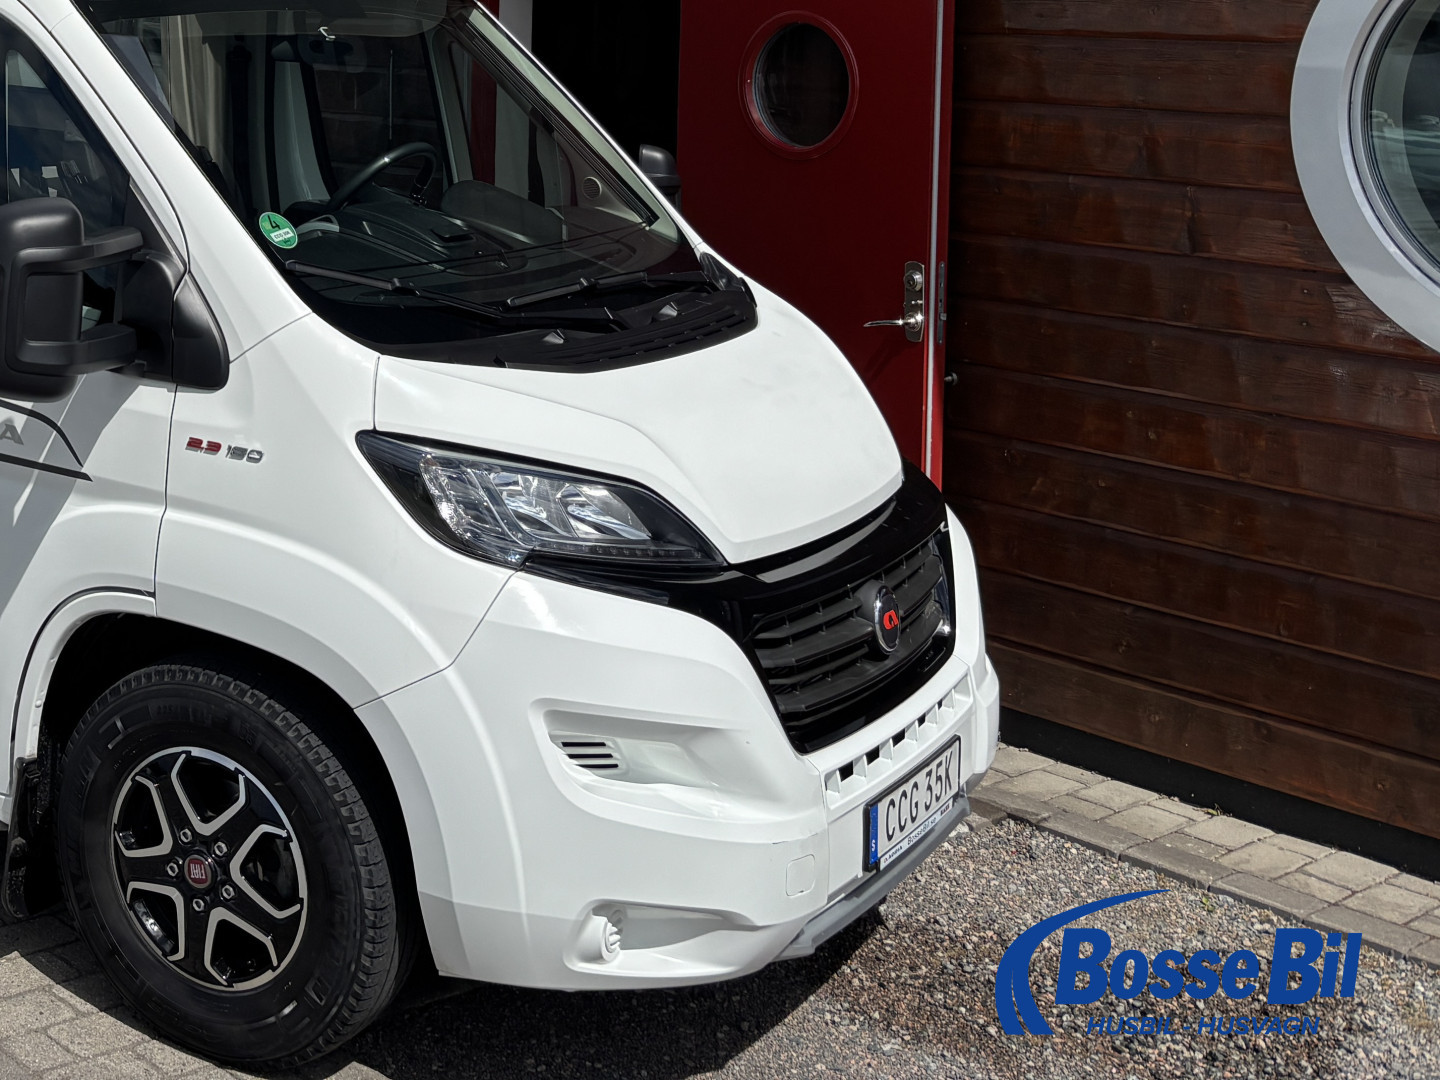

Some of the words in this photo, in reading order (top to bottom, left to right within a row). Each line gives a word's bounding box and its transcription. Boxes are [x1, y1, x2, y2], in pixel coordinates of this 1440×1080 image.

[267, 214, 281, 230] 4
[185, 436, 222, 456] 2.3
[885, 780, 919, 842] CCG
[924, 749, 954, 813] 35K
[871, 839, 876, 852] S
[190, 863, 206, 879] FIAT
